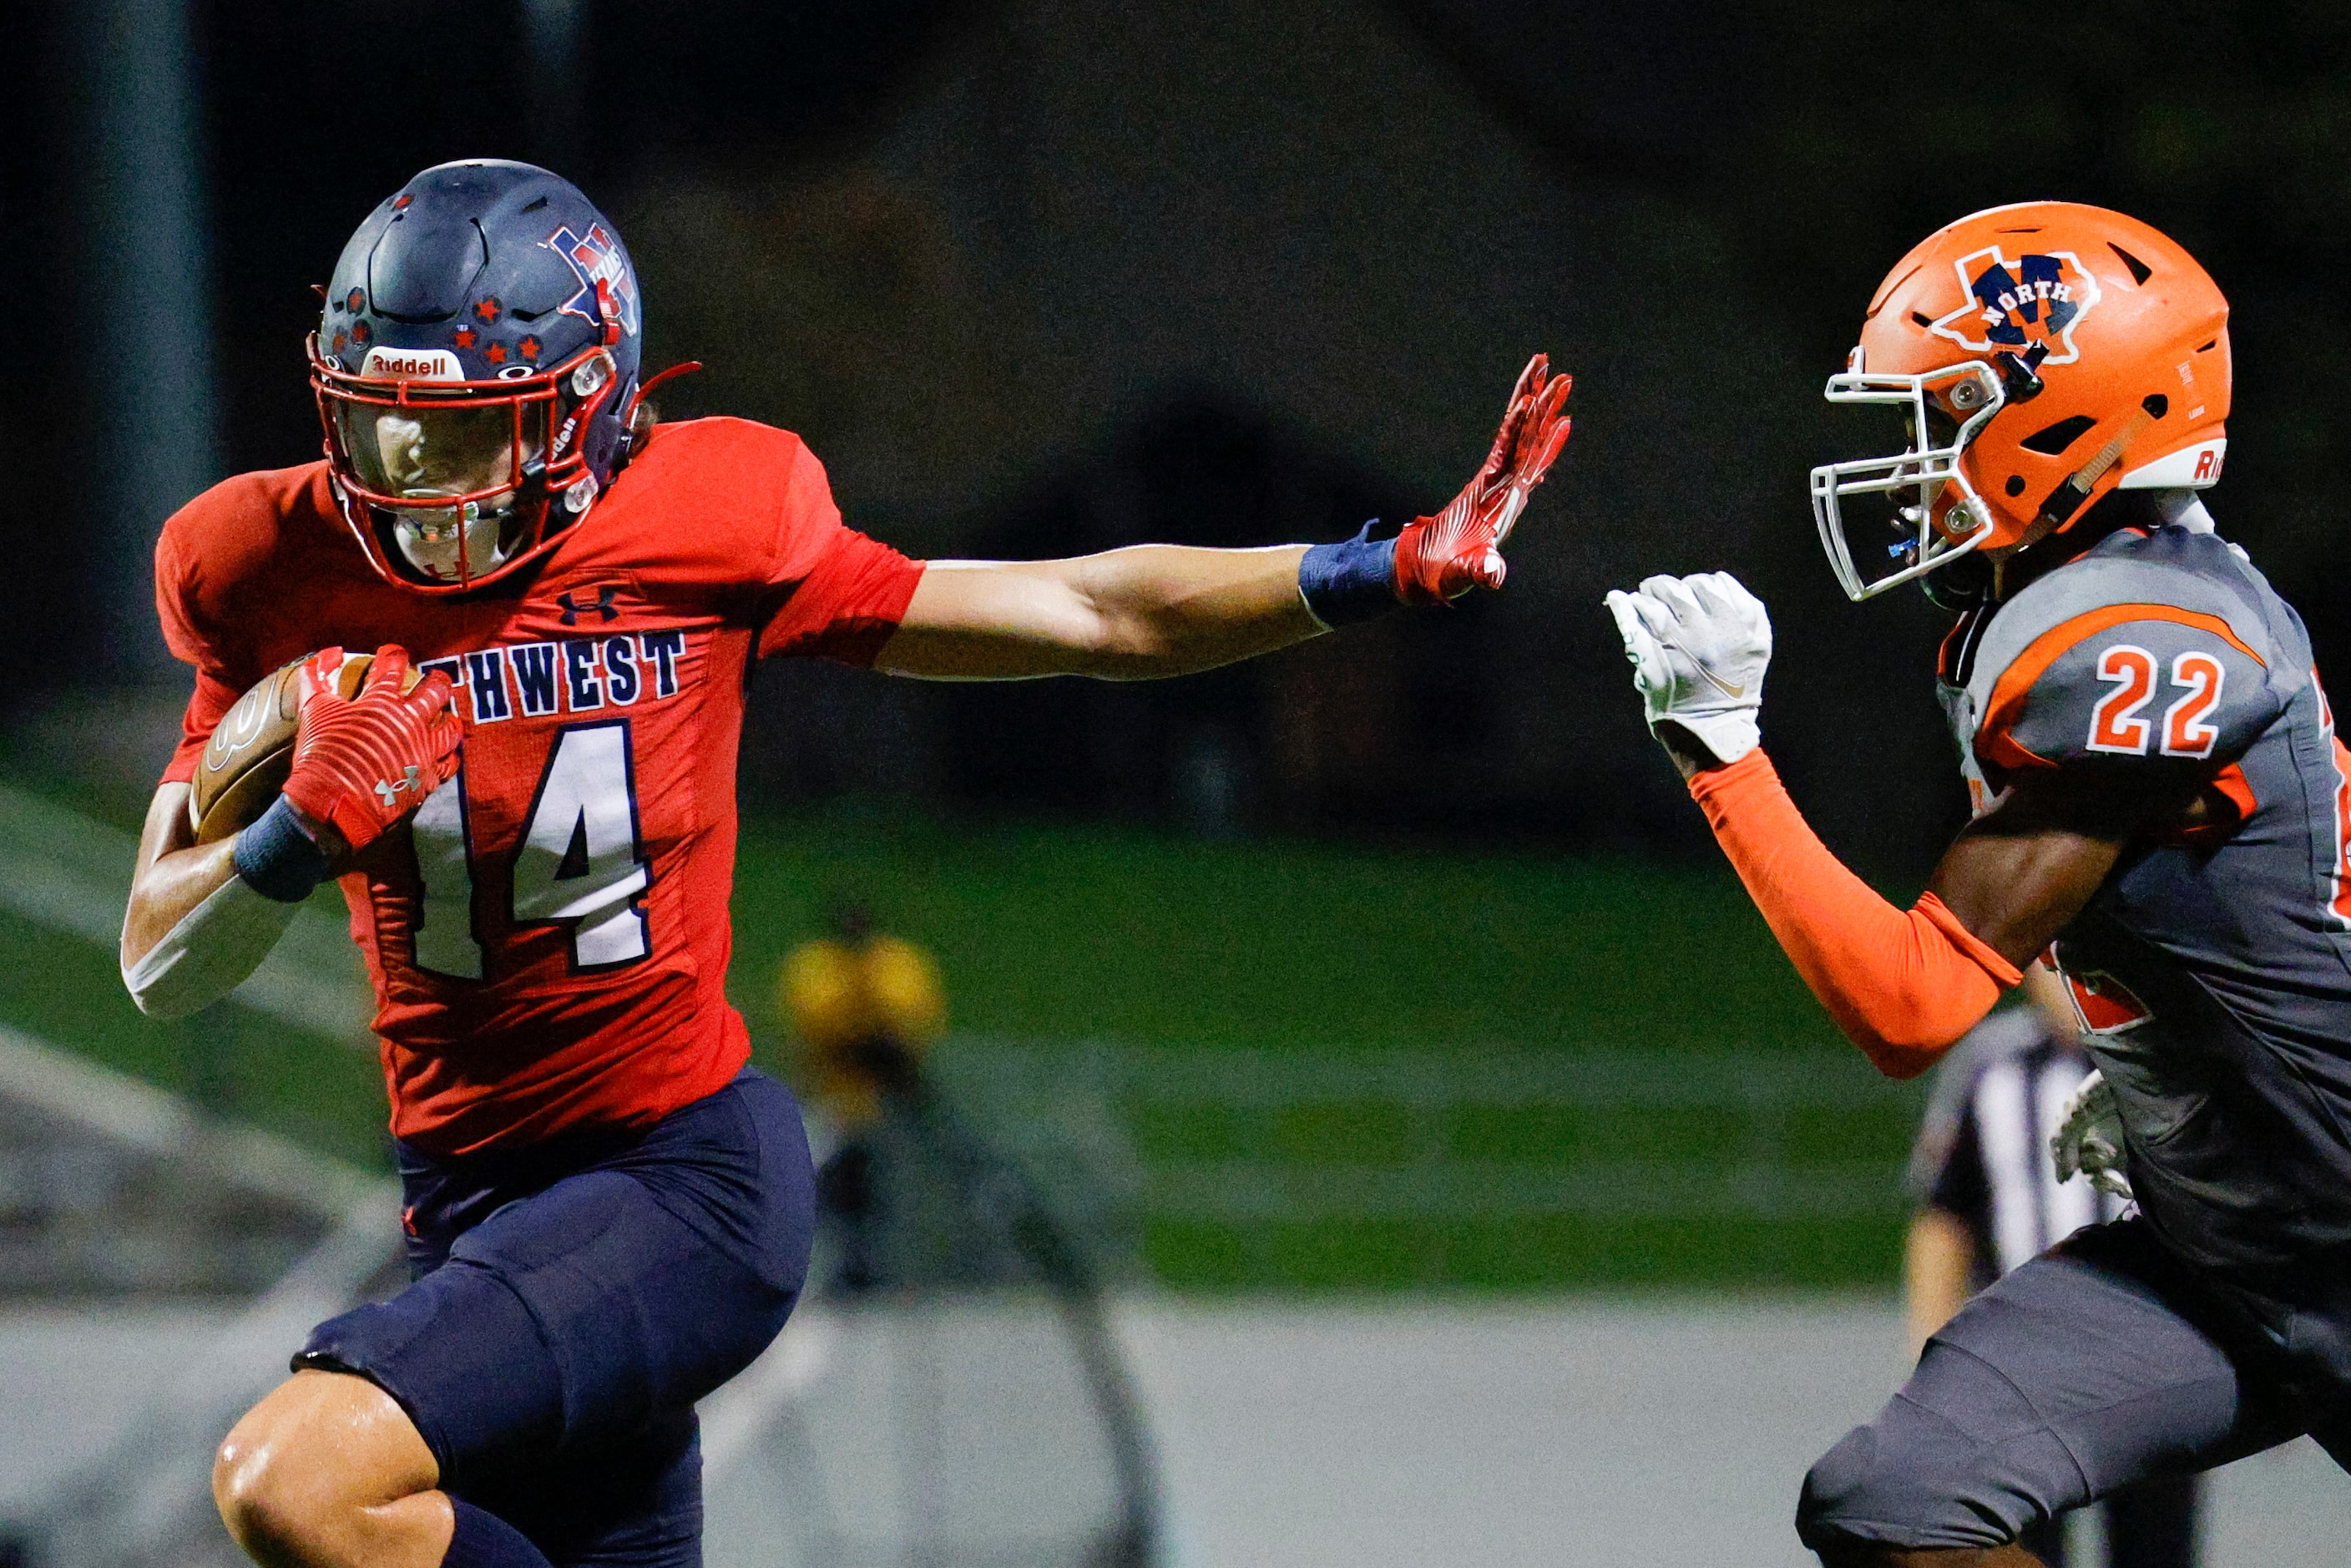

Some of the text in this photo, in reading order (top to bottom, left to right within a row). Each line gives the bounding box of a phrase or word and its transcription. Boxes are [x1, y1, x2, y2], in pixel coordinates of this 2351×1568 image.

[1980, 281, 2073, 327] NORTH
[373, 355, 445, 375] Riddell
[2086, 645, 2226, 761] 22
[409, 716, 651, 981] 14
